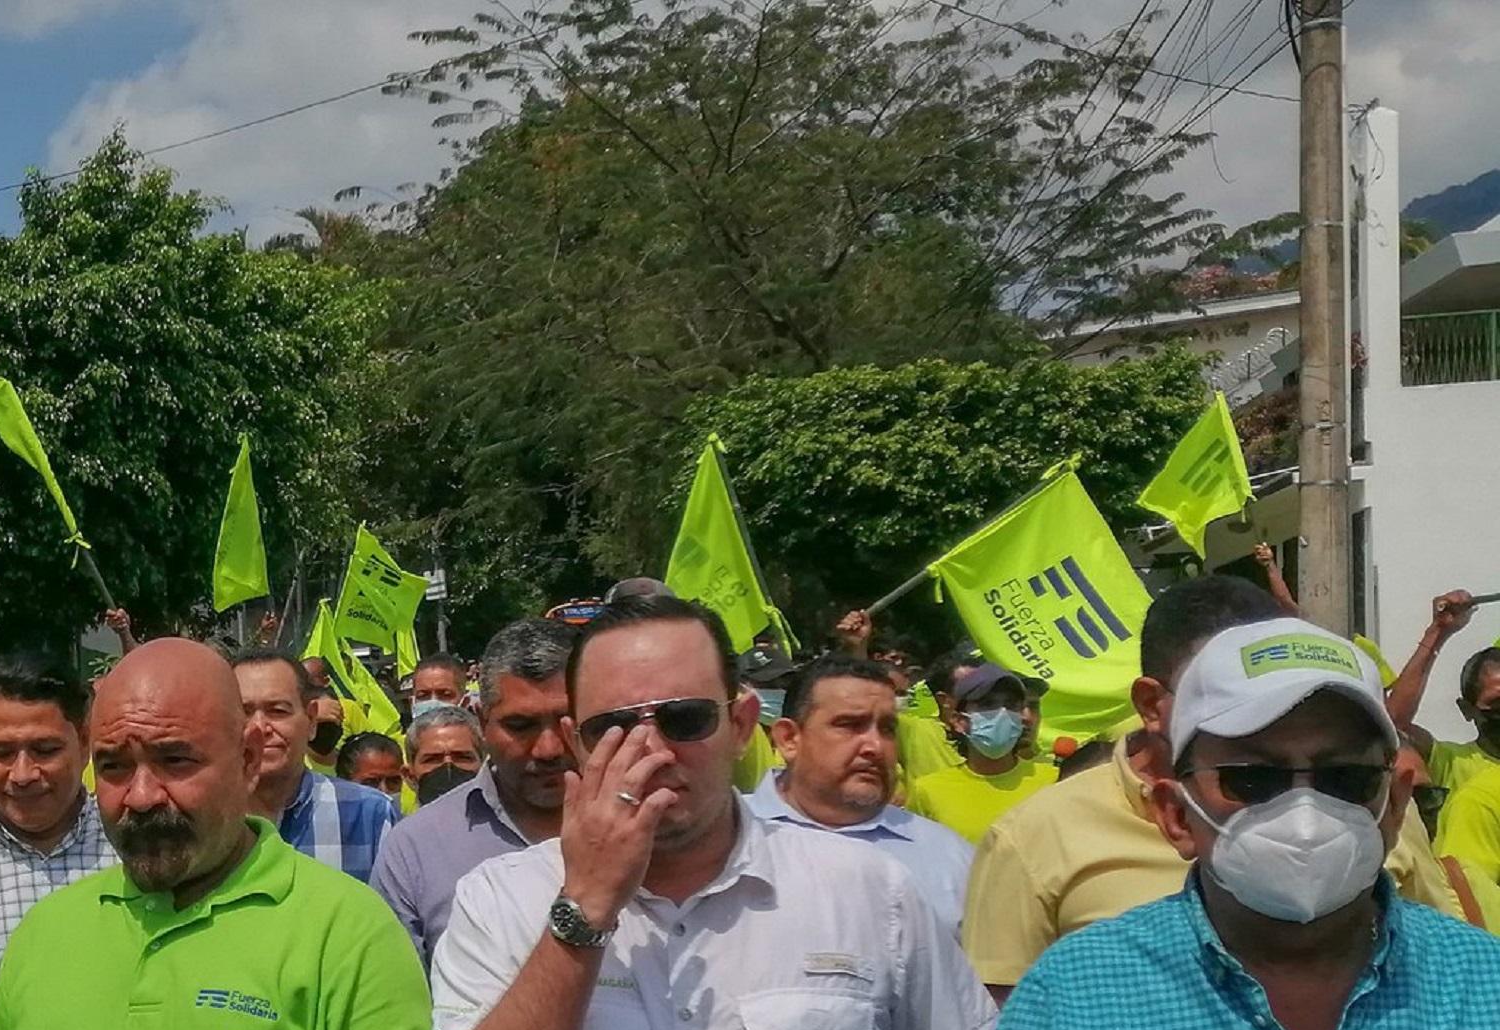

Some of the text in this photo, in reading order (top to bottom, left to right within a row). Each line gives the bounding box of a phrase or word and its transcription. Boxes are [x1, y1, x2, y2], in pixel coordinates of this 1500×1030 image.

[1001, 578, 1055, 651] Fuerza
[983, 588, 1055, 680] Solidaria
[1291, 642, 1339, 657] Fuerza
[1294, 652, 1353, 669] Solidaria
[230, 990, 271, 1008] Fuerza
[228, 1001, 279, 1021] Solidaria
